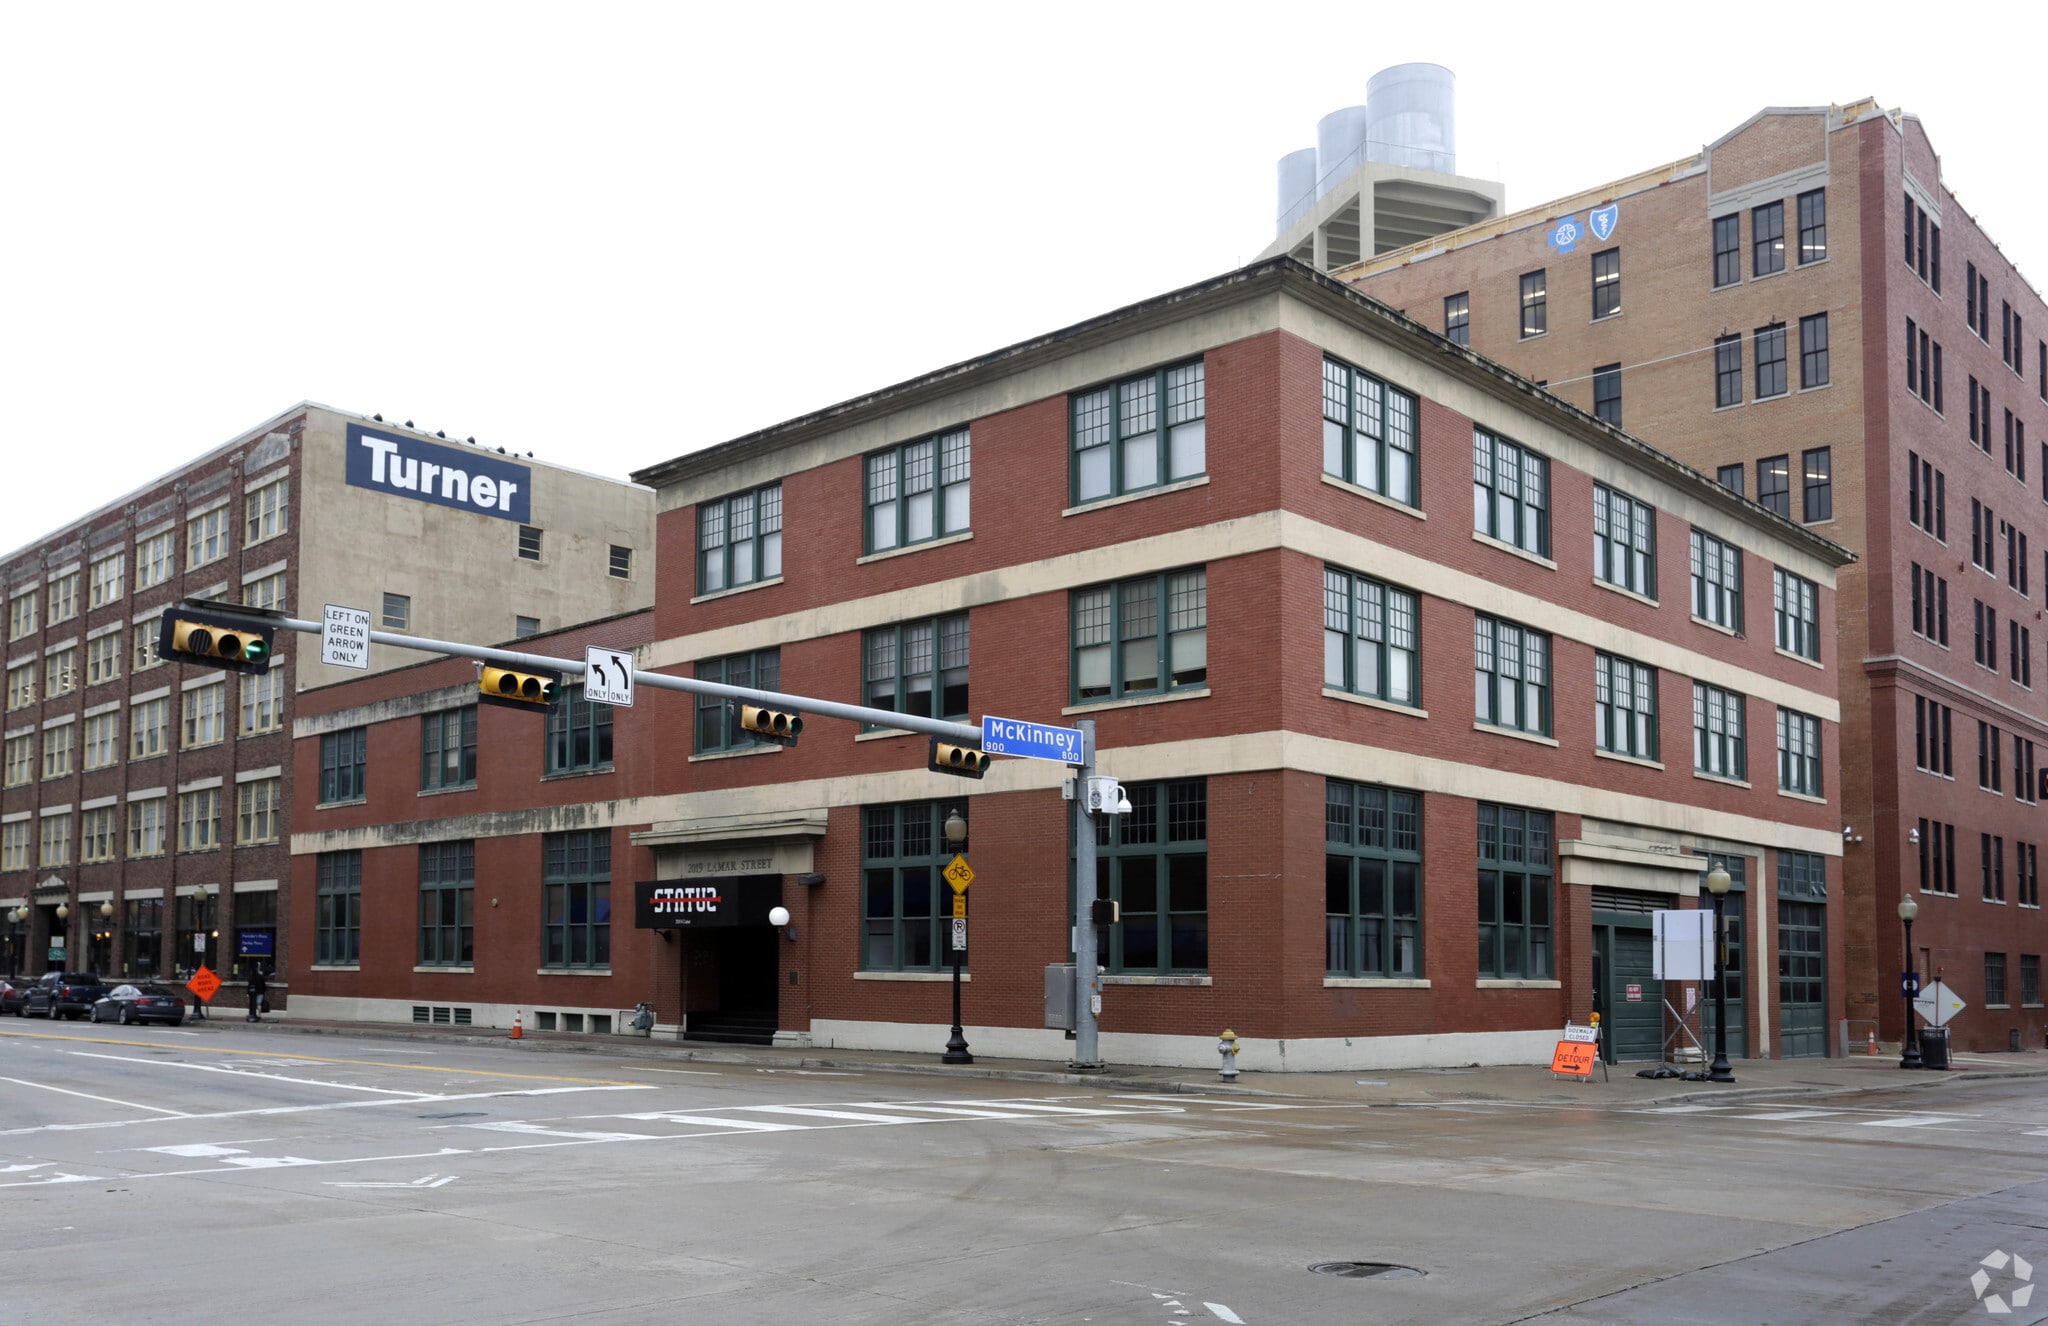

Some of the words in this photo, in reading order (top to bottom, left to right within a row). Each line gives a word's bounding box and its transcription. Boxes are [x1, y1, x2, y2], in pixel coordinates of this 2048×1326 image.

[361, 435, 517, 512] Turner
[326, 609, 351, 622] LEFT
[354, 614, 368, 625] ON
[330, 623, 363, 637] GREEN
[328, 637, 364, 651] ARROW
[332, 650, 358, 662] ONLY
[588, 688, 607, 698] ONLY
[610, 691, 629, 701] ONLY
[991, 720, 1075, 752] McKinney
[986, 741, 1005, 752] 900
[1062, 751, 1079, 761] 800
[707, 860, 737, 873] LAMAR
[740, 858, 773, 870] STREET
[1557, 1054, 1590, 1063] DETOUR
